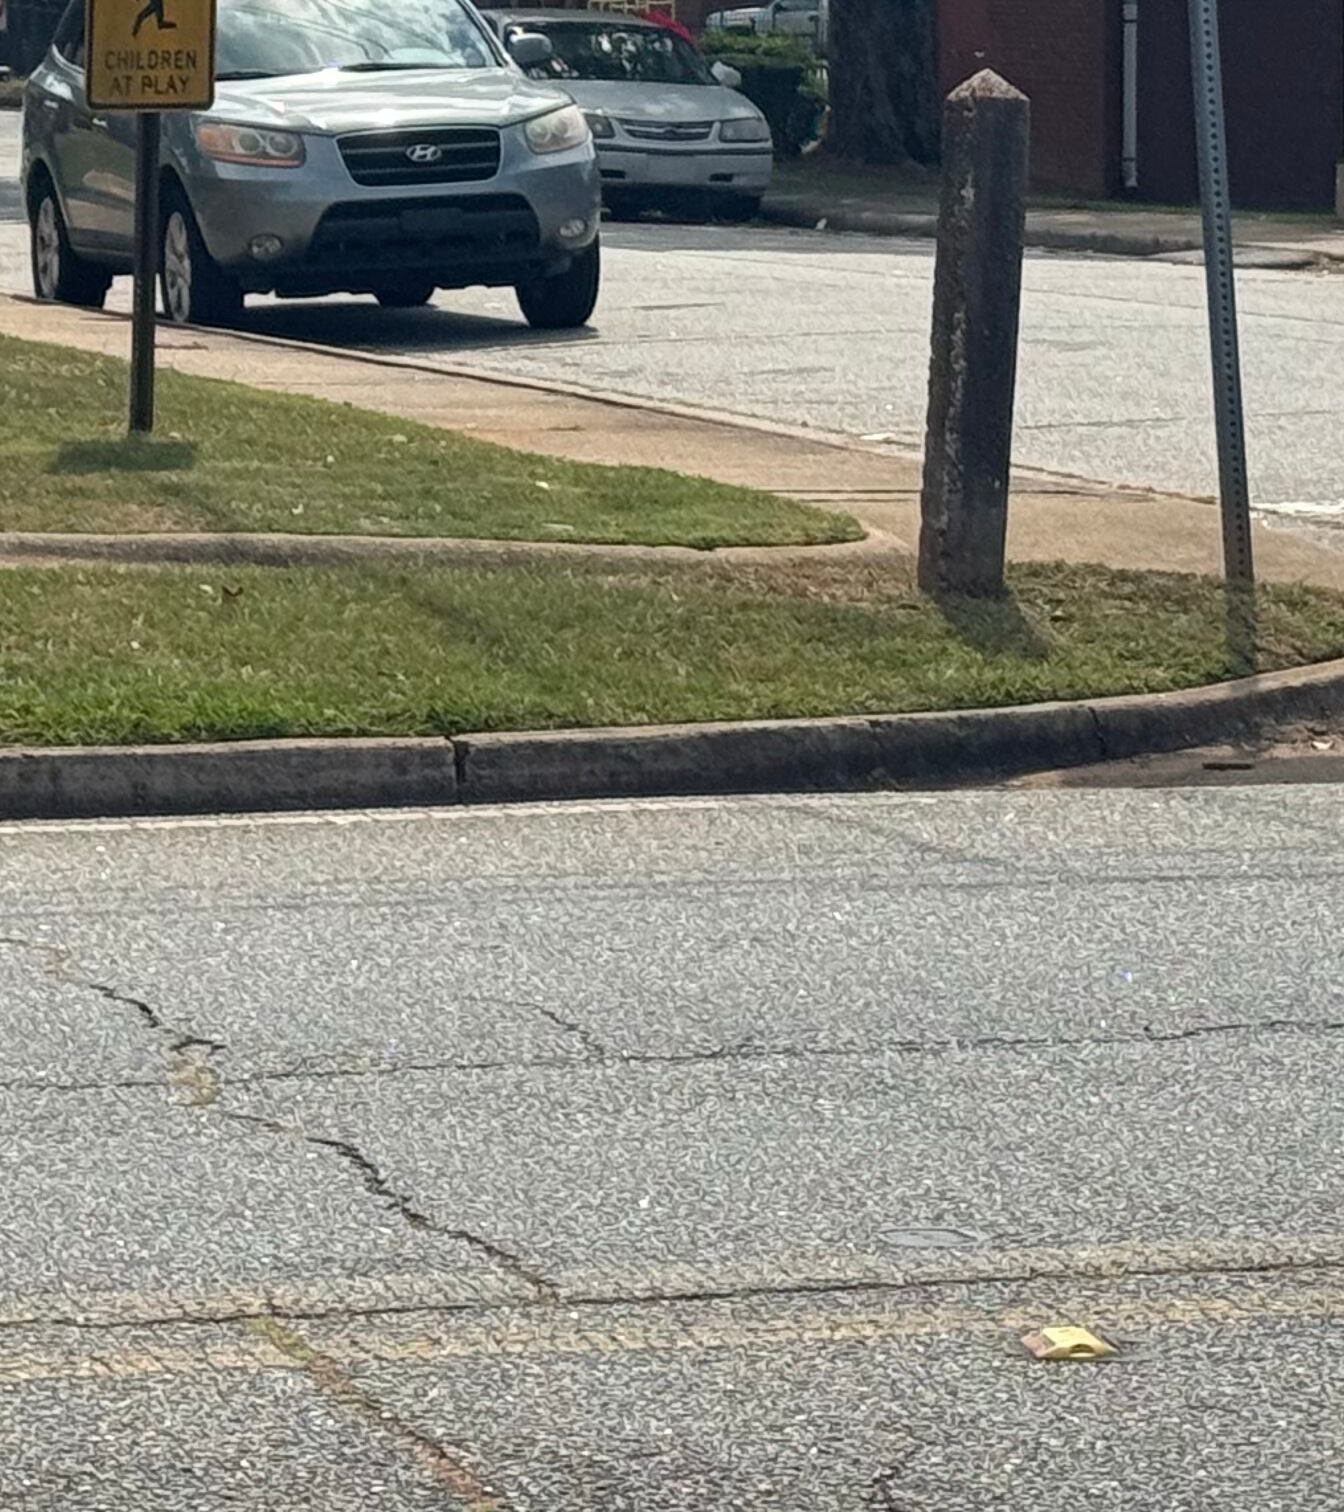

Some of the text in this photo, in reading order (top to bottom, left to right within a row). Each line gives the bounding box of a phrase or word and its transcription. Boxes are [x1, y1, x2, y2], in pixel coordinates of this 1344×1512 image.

[105, 49, 197, 71] CHILDREN
[112, 75, 190, 96] AT PLAY
